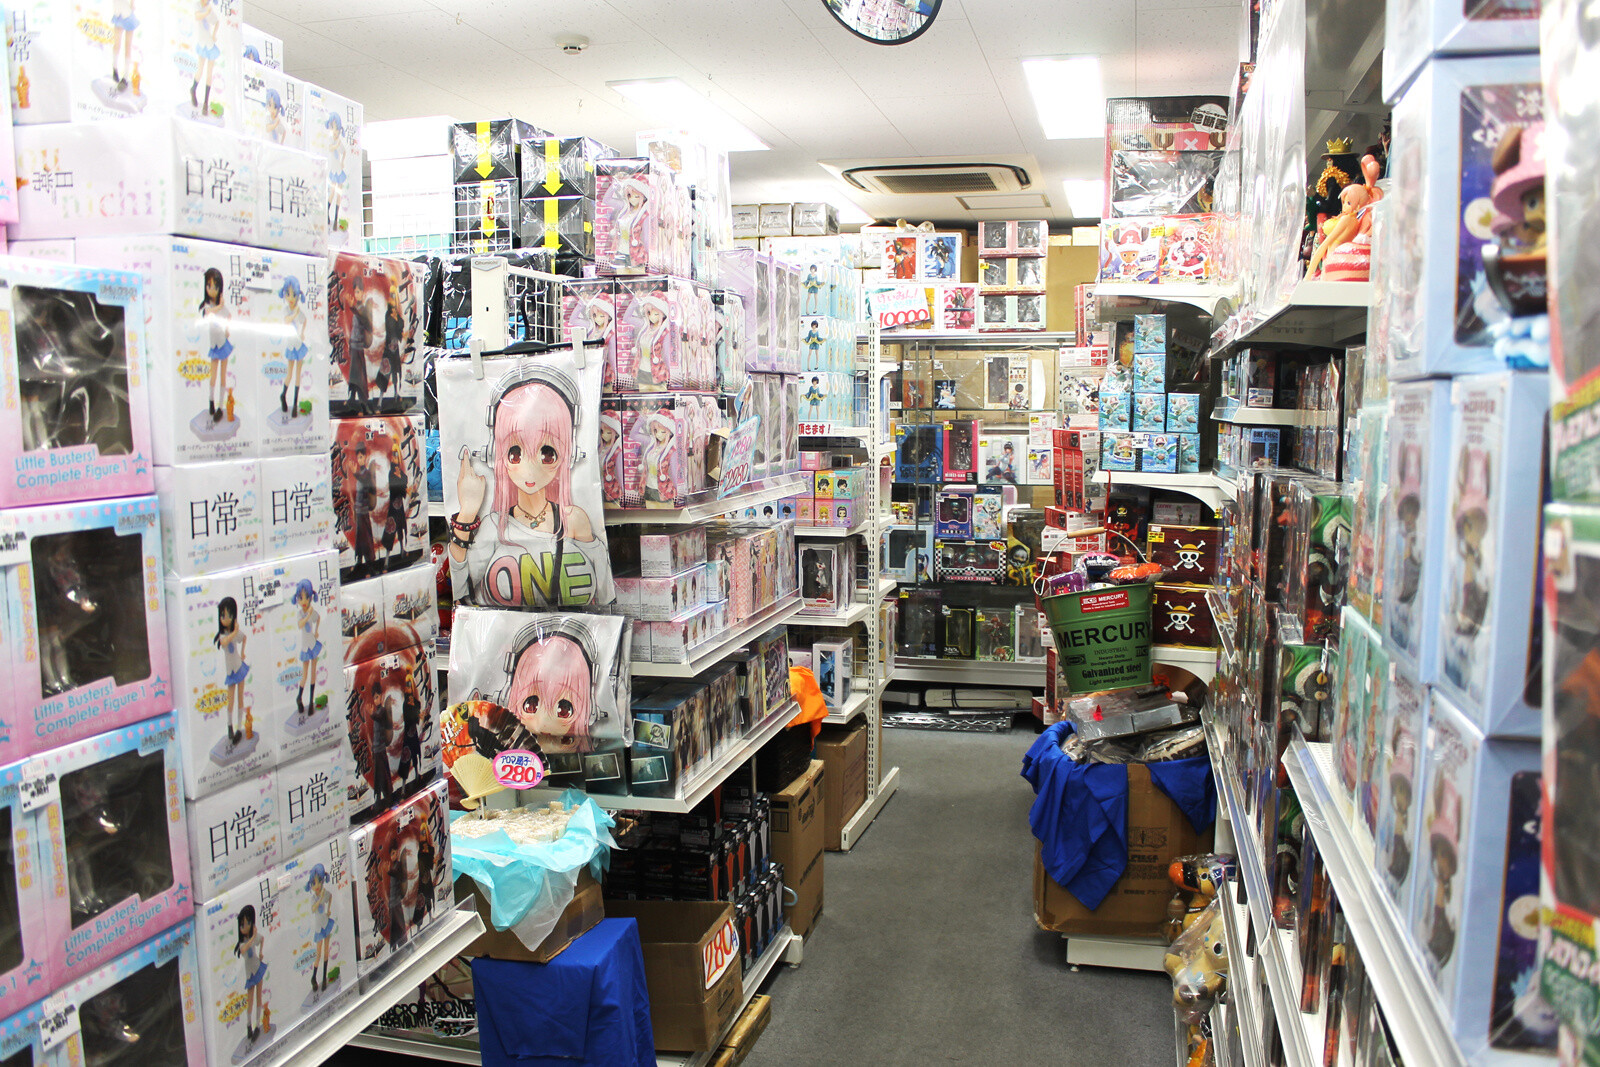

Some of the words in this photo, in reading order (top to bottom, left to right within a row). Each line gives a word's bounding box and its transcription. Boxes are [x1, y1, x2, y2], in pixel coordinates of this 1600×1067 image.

[286, 82, 301, 127] 日常
[344, 105, 357, 147] 日常
[185, 158, 235, 204] 日常
[269, 175, 310, 218] 日常
[229, 255, 245, 306] 日常
[306, 264, 321, 310] 日常
[880, 309, 929, 328] 10000
[15, 455, 46, 472] Little
[50, 448, 96, 467] Busters!
[16, 467, 82, 489] Complete
[85, 463, 120, 481] Figure
[122, 460, 128, 472] 1
[190, 492, 239, 540] 日常
[272, 482, 313, 526] 日常
[186, 585, 202, 595] SEGA
[242, 576, 257, 626] 日常
[318, 560, 331, 606] 日常
[486, 552, 593, 607] ONE
[1098, 593, 1125, 602] MERCURY
[1082, 665, 1125, 679] Galvanized
[34, 700, 65, 722] Little
[68, 682, 114, 710] Busters!
[35, 705, 100, 738] Complete
[103, 692, 138, 712] Figure
[140, 686, 146, 699] 1
[288, 772, 328, 823] 日常
[209, 805, 257, 863] 日常
[285, 860, 299, 871] SEGA
[329, 839, 342, 884] 日常
[207, 902, 223, 916] SEGA
[260, 878, 274, 927] 日常
[64, 926, 92, 953] Little
[95, 900, 140, 934] Busters!
[66, 924, 125, 968] Complete
[129, 903, 162, 930] Figure
[164, 896, 170, 908] 1
